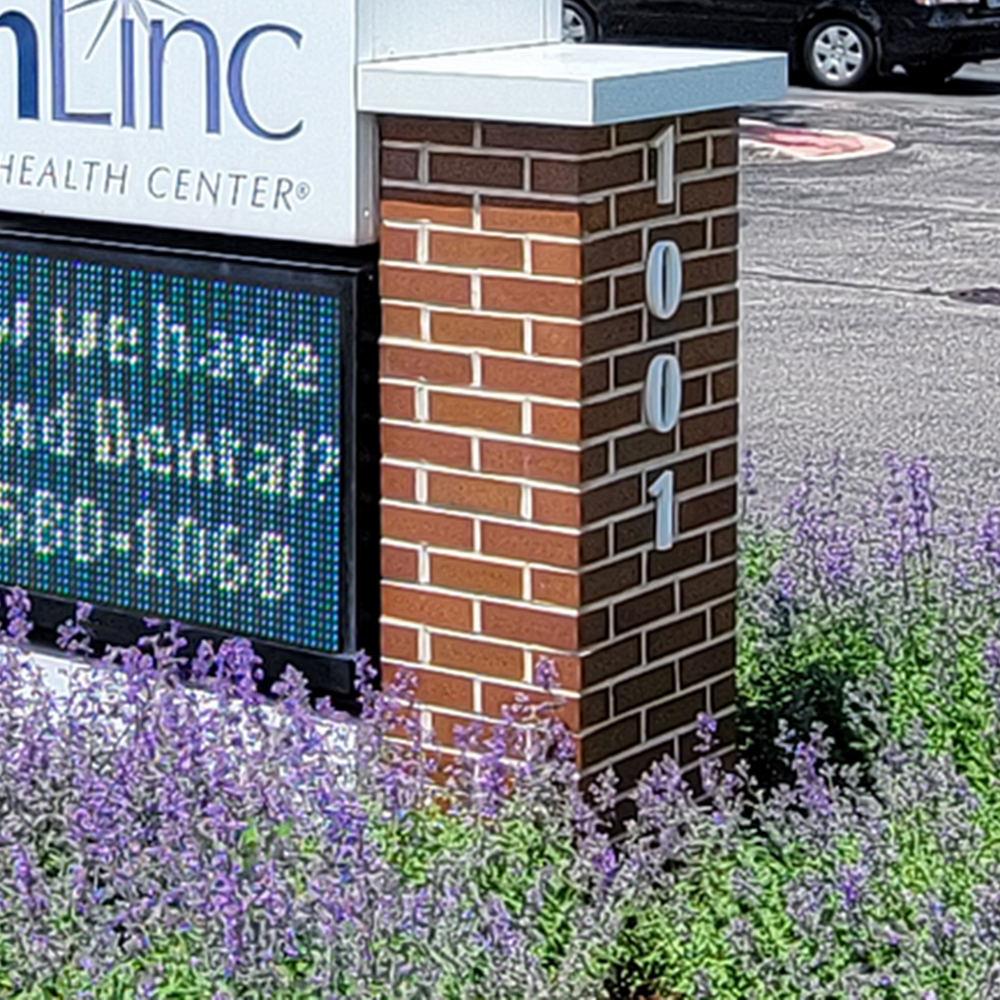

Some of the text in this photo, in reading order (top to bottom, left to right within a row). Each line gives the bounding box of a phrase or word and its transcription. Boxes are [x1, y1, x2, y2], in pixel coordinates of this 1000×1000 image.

[51, 304, 139, 365] we
[154, 300, 319, 394] have
[95, 396, 340, 502] Dental?
